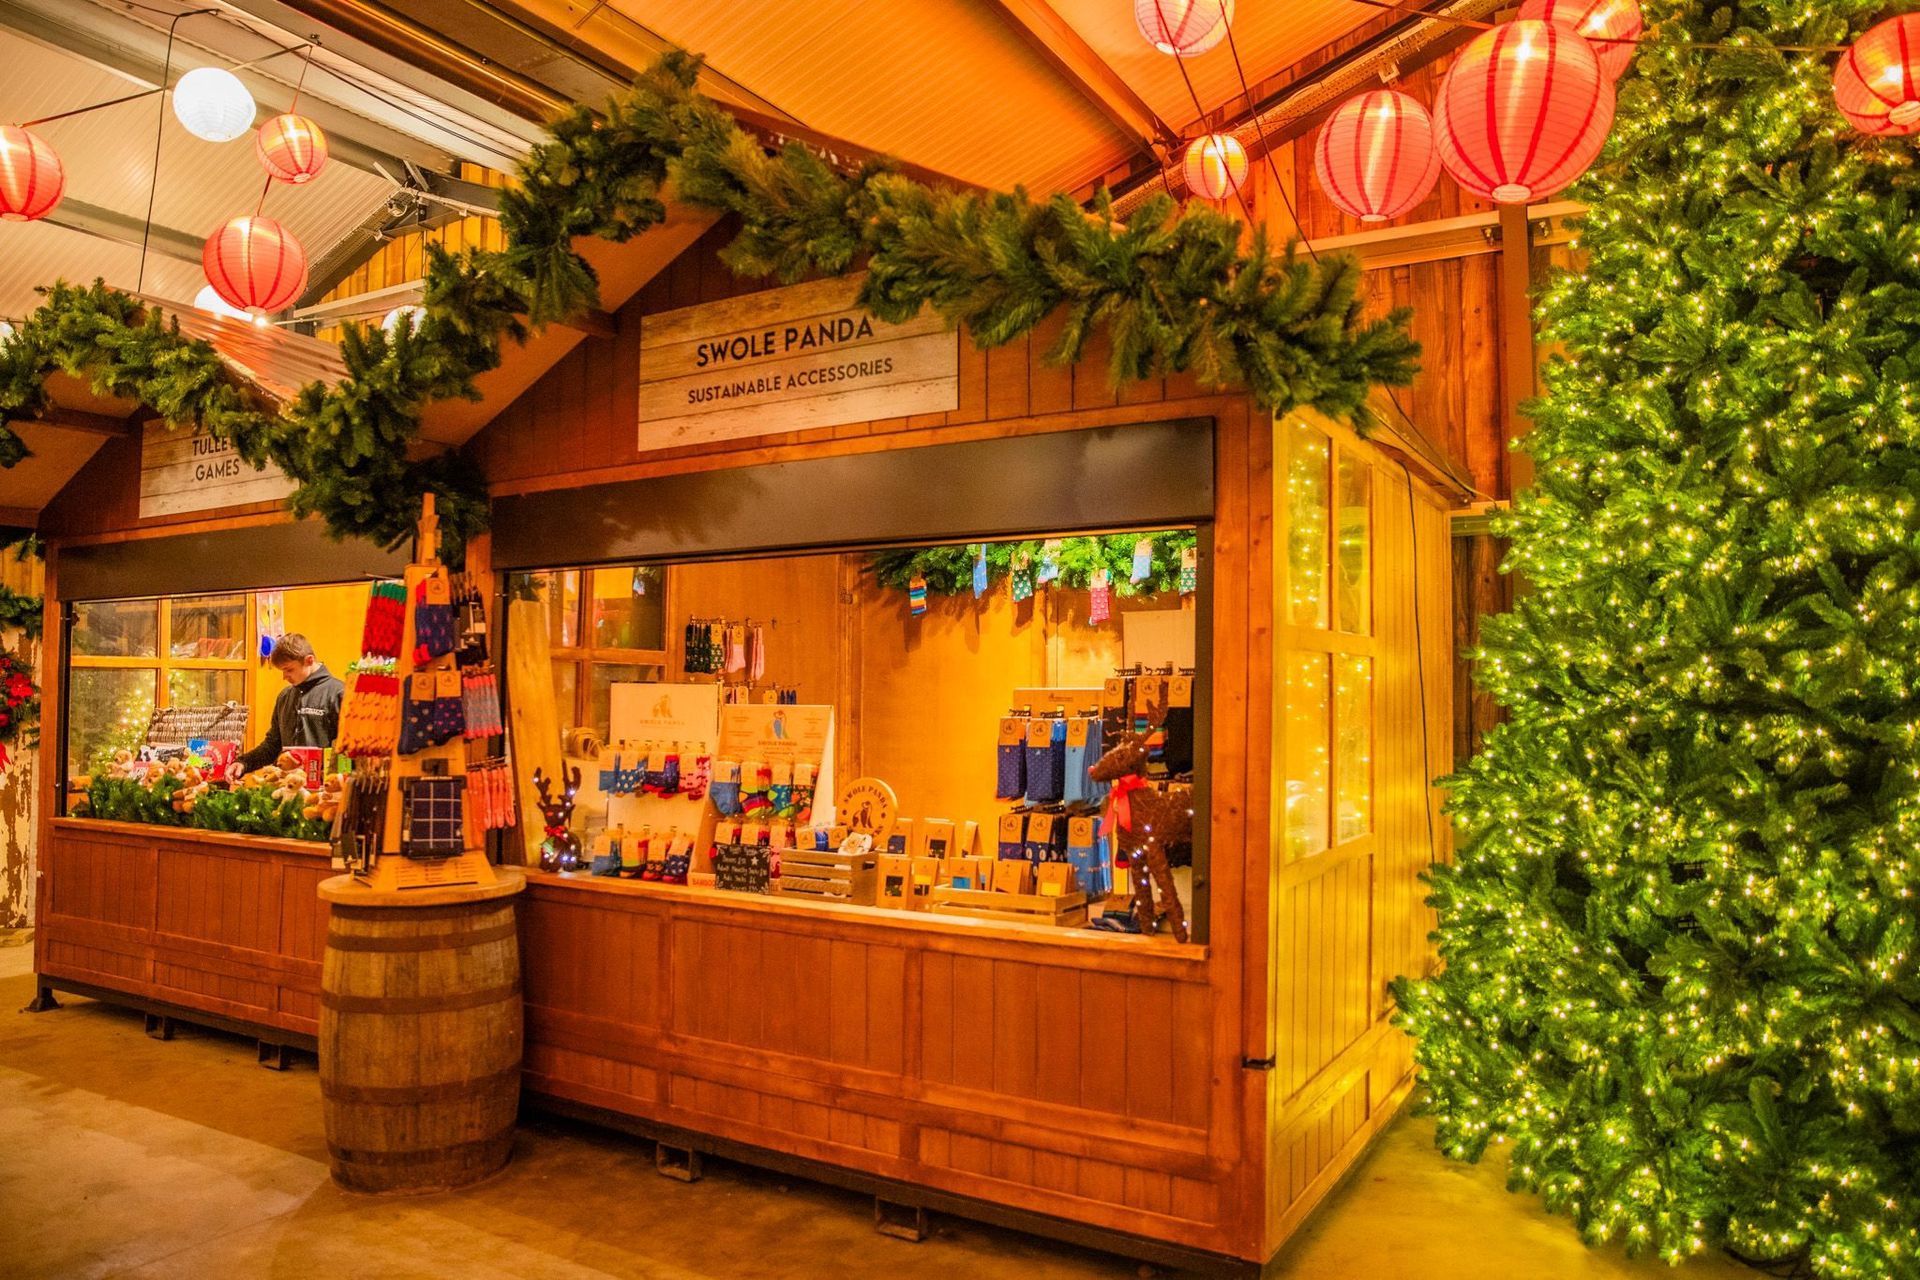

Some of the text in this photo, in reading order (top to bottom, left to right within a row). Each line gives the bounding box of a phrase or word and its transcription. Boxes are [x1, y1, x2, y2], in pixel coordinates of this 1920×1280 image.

[696, 315, 875, 368] SWOLE PANDA
[687, 357, 894, 405] SUSTAINABLE ACCESSORIES
[195, 458, 240, 481] GAMES
[843, 784, 889, 809] SWOLE PANDA
